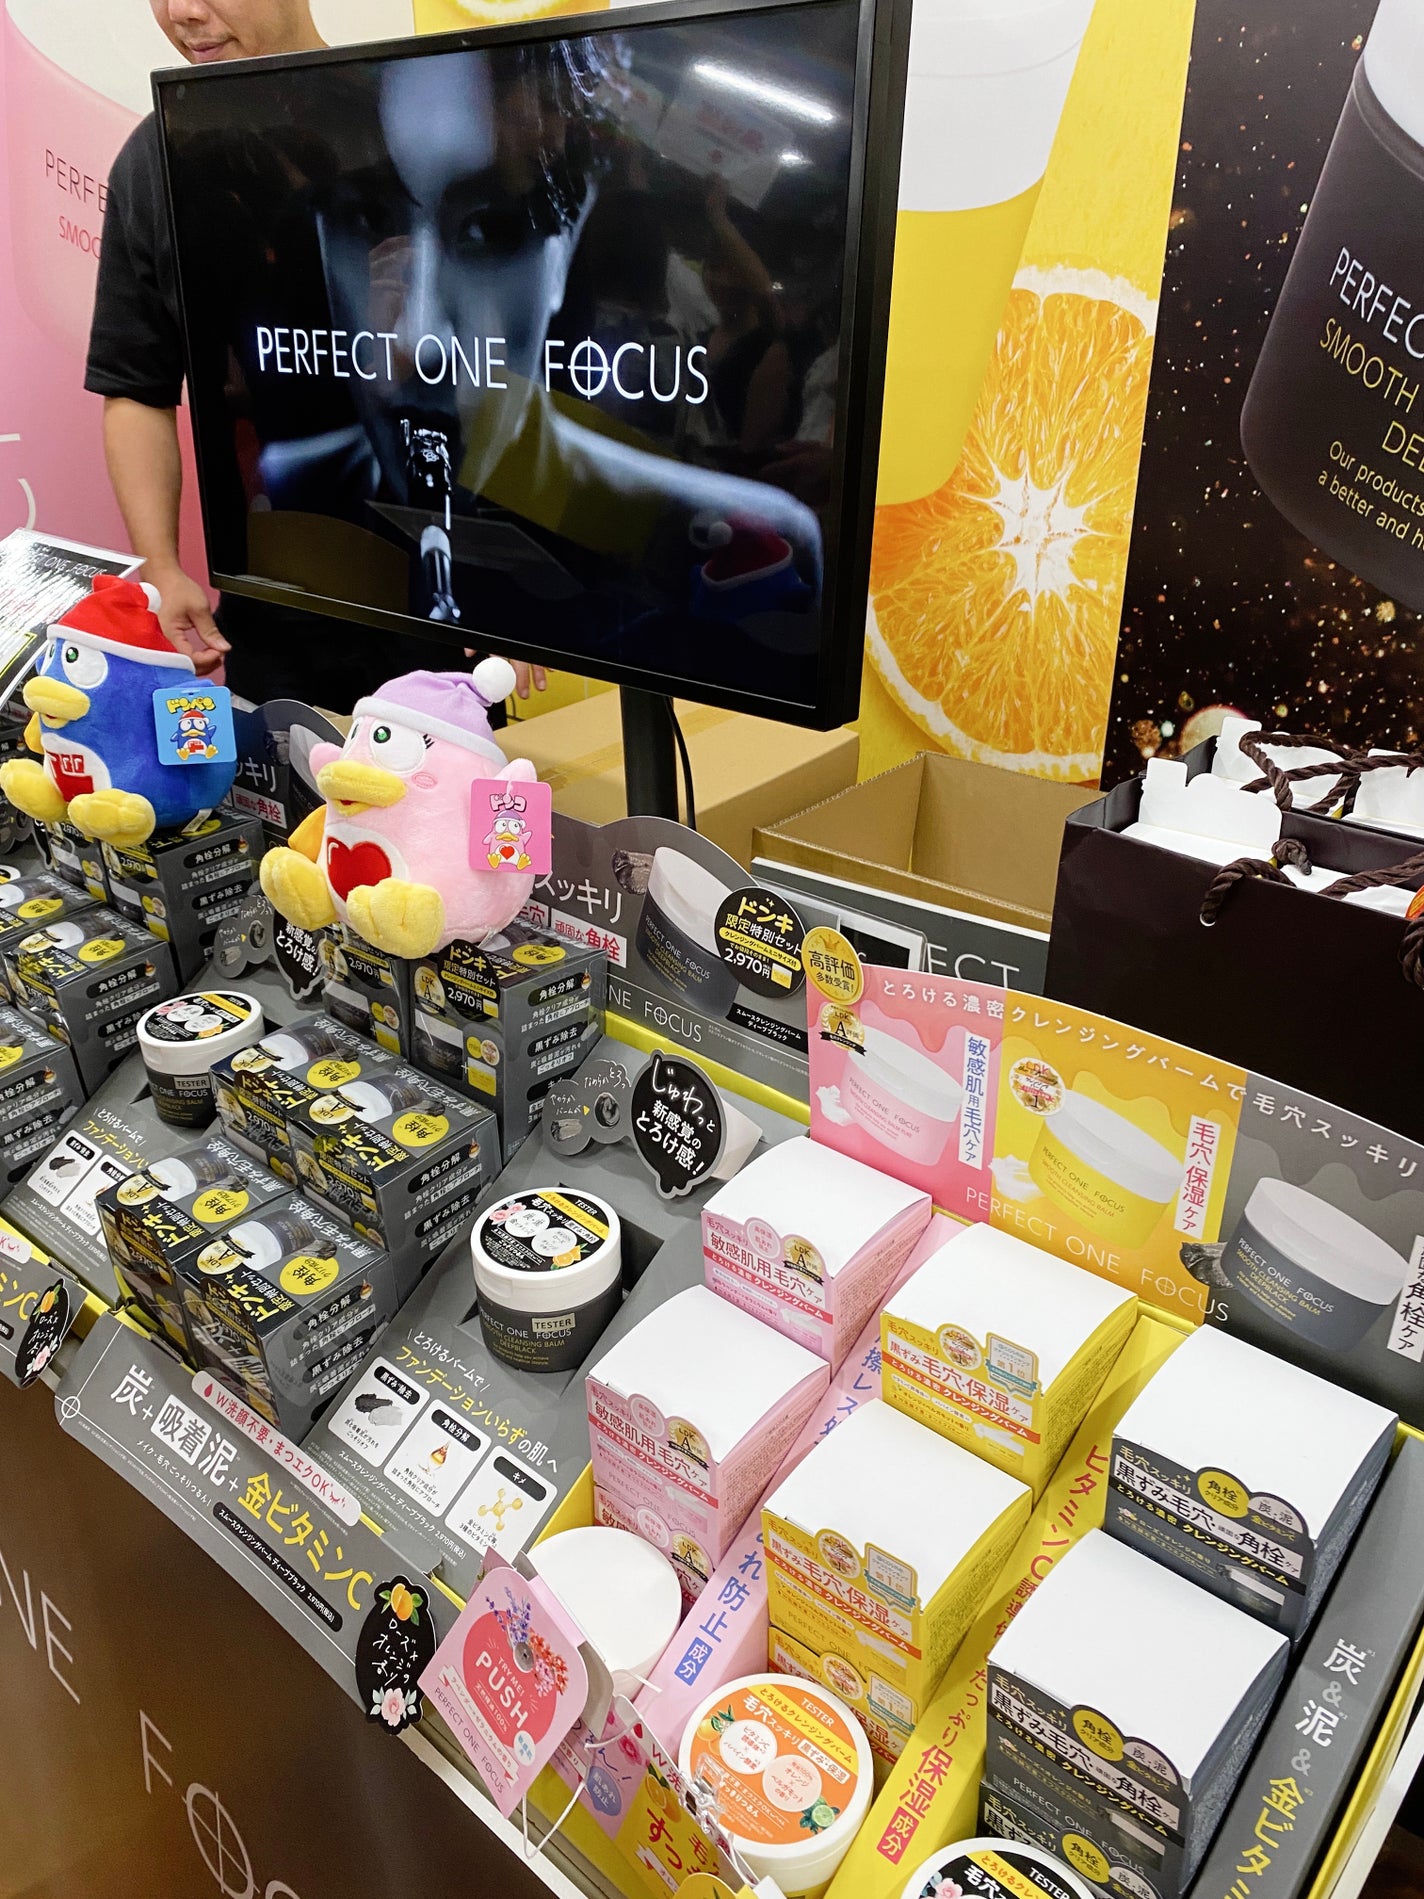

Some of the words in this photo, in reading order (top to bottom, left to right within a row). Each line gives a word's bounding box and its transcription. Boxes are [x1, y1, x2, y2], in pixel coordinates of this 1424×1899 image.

[257, 326, 398, 381] PERFECT
[414, 333, 508, 389] ONE
[544, 335, 710, 404] FOCUS
[1320, 318, 1419, 413] SMOOTH
[1329, 441, 1355, 470] Our
[1318, 470, 1328, 485] a
[1329, 477, 1373, 517] better
[1376, 510, 1413, 540] and
[725, 912, 802, 955] 限定特別セット
[738, 896, 794, 933] ドンキ
[449, 945, 487, 971] ドンキ
[808, 949, 856, 981] 高評価
[644, 1000, 702, 1044] FOCUS
[651, 1098, 703, 1150] 新感覚の
[652, 1058, 716, 1133] じゅわっと
[963, 1036, 988, 1163] 敏感肌用毛穴ケア
[635, 1112, 706, 1176] とろけ感!
[1068, 1171, 1089, 1190] ONE
[1182, 1121, 1216, 1231] 毛穴・保湿ケア
[204, 1196, 232, 1216] 角栓
[574, 1199, 598, 1216] TESTER
[292, 1265, 322, 1286] 角栓
[710, 1231, 823, 1304] 敏感肌用毛穴ケア
[965, 1186, 1058, 1241] PERFECT
[1065, 1233, 1121, 1275] ONE
[1140, 1267, 1231, 1322] FOCUS
[1238, 1237, 1267, 1267] PERFECT
[1267, 1266, 1292, 1288] ONE
[1296, 1287, 1335, 1313] FOCUS
[506, 1326, 529, 1339] ONE
[534, 1318, 572, 1330] TESTER
[413, 1331, 486, 1388] とろけるバームで
[890, 1340, 1029, 1422] 黒ずみ毛穴・保湿ケア
[396, 1345, 559, 1475] ファンデーションいらずの肌へ
[943, 1387, 1028, 1438] クレンジングバーム
[215, 1390, 333, 1496] W洗顔不要・まつエクOK
[594, 1400, 708, 1487] 敏感肌用毛穴ケア
[1119, 1444, 1192, 1495] 毛穴スッキリ
[1207, 1478, 1238, 1503] 角栓
[1182, 1523, 1289, 1586] クレンジングバーム
[475, 1650, 529, 1729] PUSH
[497, 1656, 513, 1677] TRY
[510, 1675, 525, 1697] ME!
[994, 1673, 1068, 1732] 毛穴スッキリ
[743, 1695, 800, 1746] 毛穴スッキリ
[759, 1687, 853, 1764] とろけるクレンジングバーム
[801, 1697, 836, 1727] TESTER
[1082, 1719, 1113, 1746] 角栓
[434, 1687, 464, 1726] PERFECT
[463, 1727, 480, 1753] ONE
[480, 1755, 504, 1795] FOCUS
[1013, 1776, 1062, 1817] PERFECT
[1064, 1815, 1093, 1837] ONE
[1061, 1760, 1168, 1837] クレンジングバーム
[1070, 1839, 1100, 1867] 角栓
